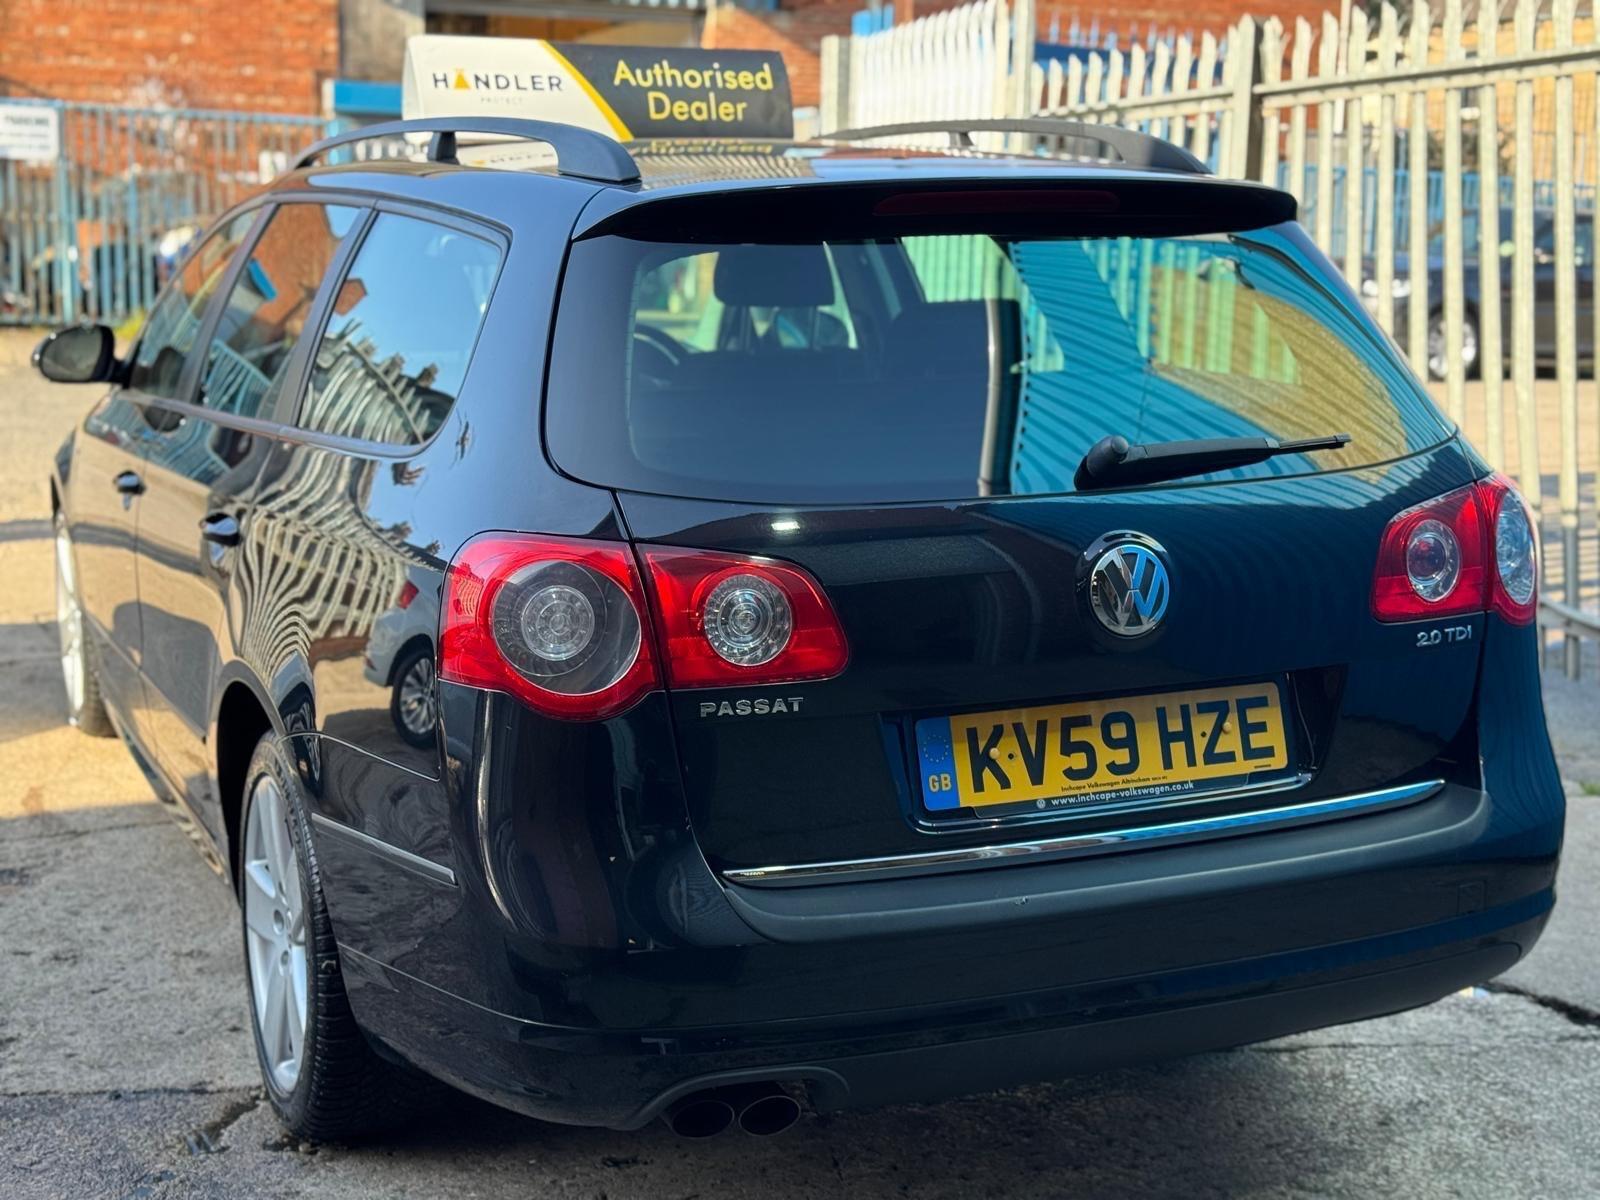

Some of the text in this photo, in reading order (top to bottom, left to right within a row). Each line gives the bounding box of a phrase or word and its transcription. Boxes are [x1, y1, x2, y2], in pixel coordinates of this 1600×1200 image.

[613, 59, 774, 91] Authorised
[647, 91, 748, 122] Dealer
[1444, 624, 1472, 642] TDI
[700, 697, 804, 718] PASSAT
[965, 695, 1276, 793] KV59 HZE
[928, 773, 952, 792] GB
[1051, 781, 1195, 806] www.inchcape-volkswagen.co.uk
[1086, 781, 1121, 790] Volkswagen
